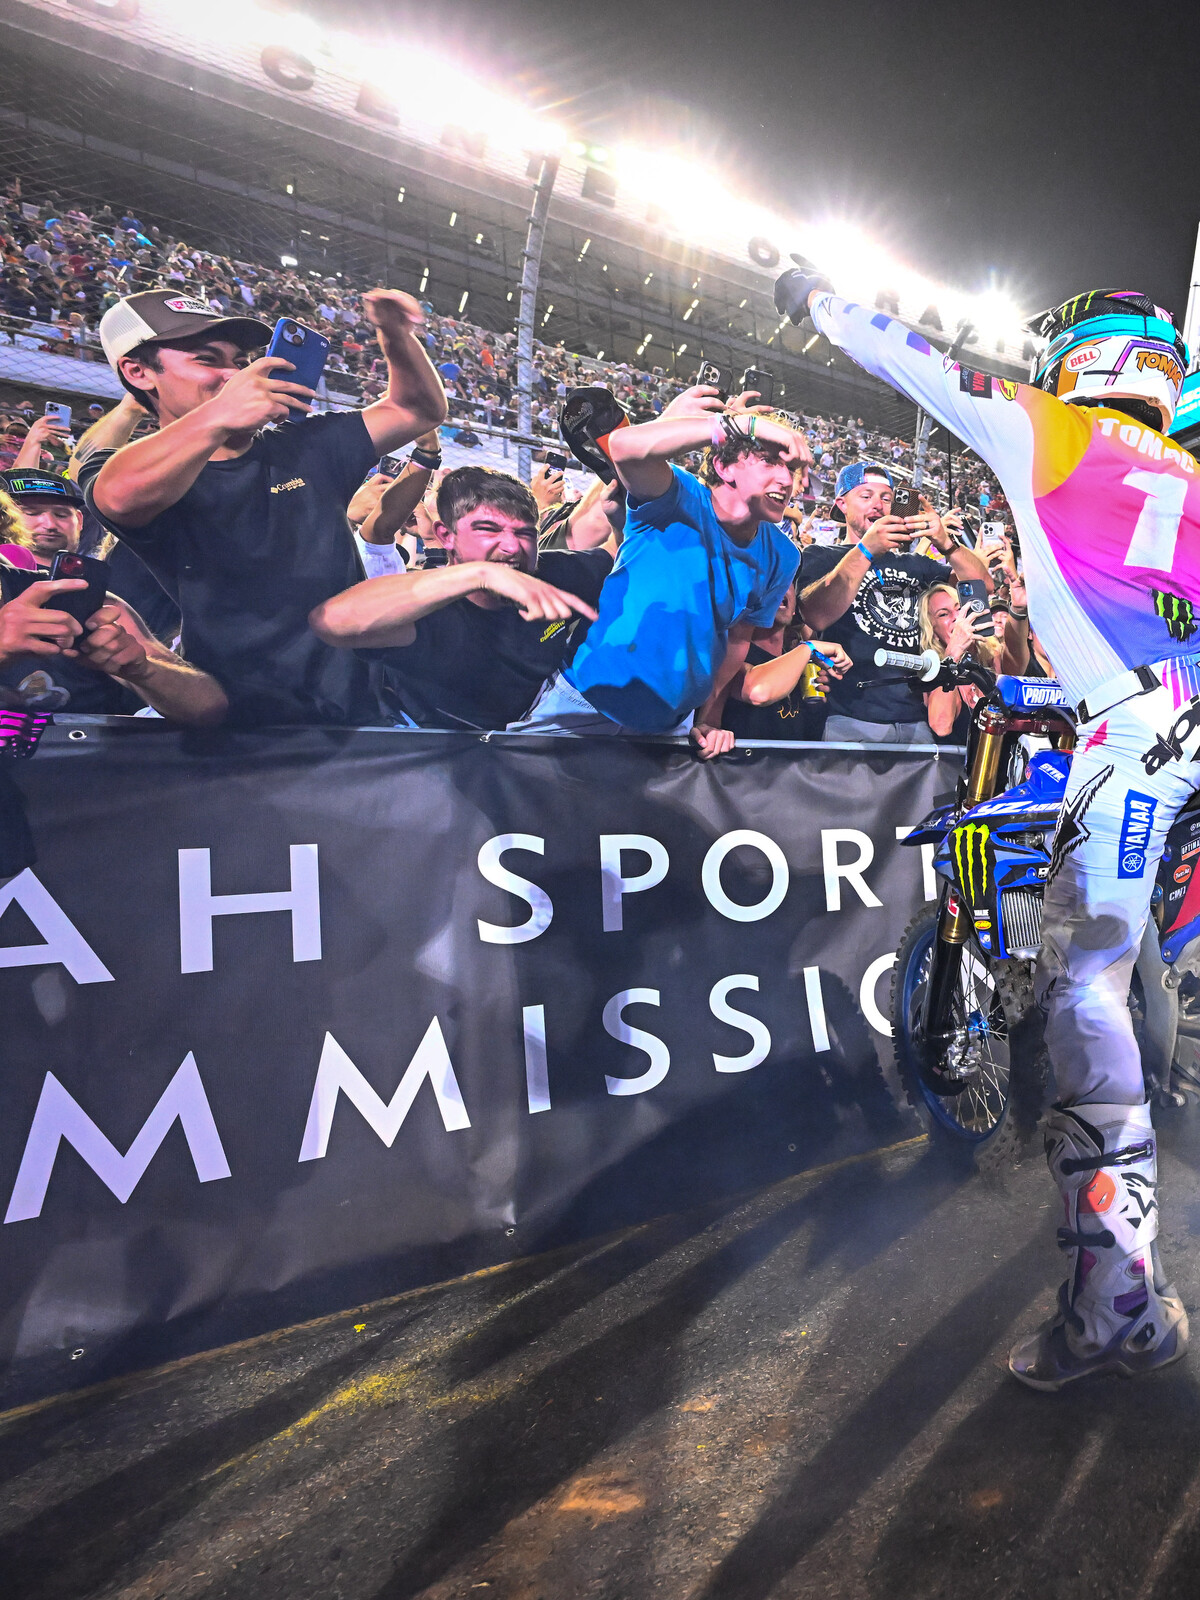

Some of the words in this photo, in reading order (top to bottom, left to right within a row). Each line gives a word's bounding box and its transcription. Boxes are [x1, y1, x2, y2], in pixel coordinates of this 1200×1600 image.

[1070, 351, 1096, 368] BELL
[1137, 351, 1182, 391] TOMAC
[1098, 418, 1195, 474] TOMAC
[1122, 466, 1188, 573] 1
[1039, 763, 1066, 783] GYTR
[969, 801, 1034, 817] YZ
[1181, 840, 1200, 855] OPTIMA
